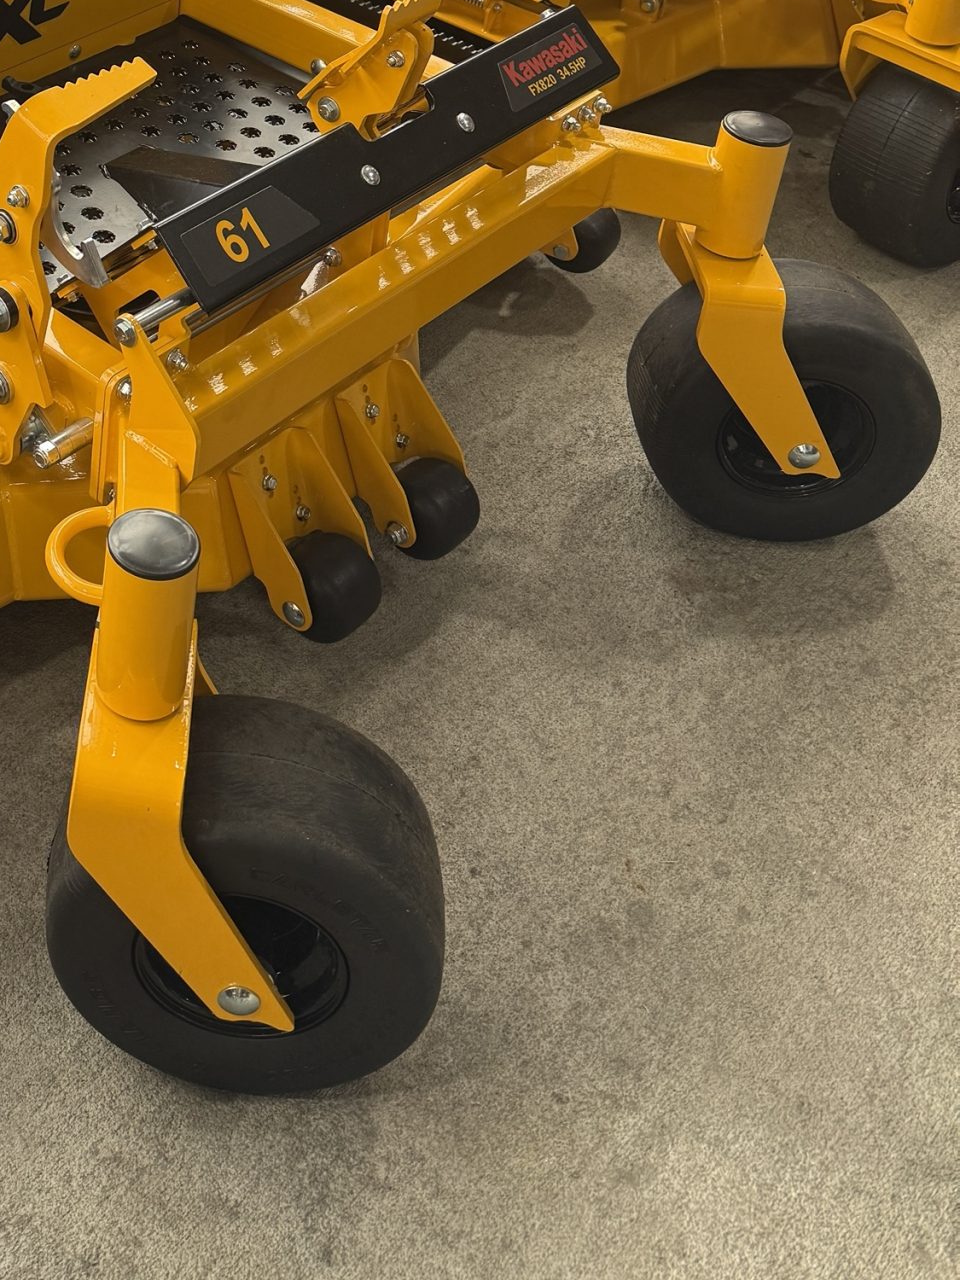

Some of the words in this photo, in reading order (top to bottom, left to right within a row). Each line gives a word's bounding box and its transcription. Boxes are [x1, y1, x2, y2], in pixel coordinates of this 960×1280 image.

[502, 27, 588, 88] Kawasaki
[527, 74, 557, 97] FX820
[556, 56, 587, 80] 34.5HP
[215, 207, 271, 263] 61
